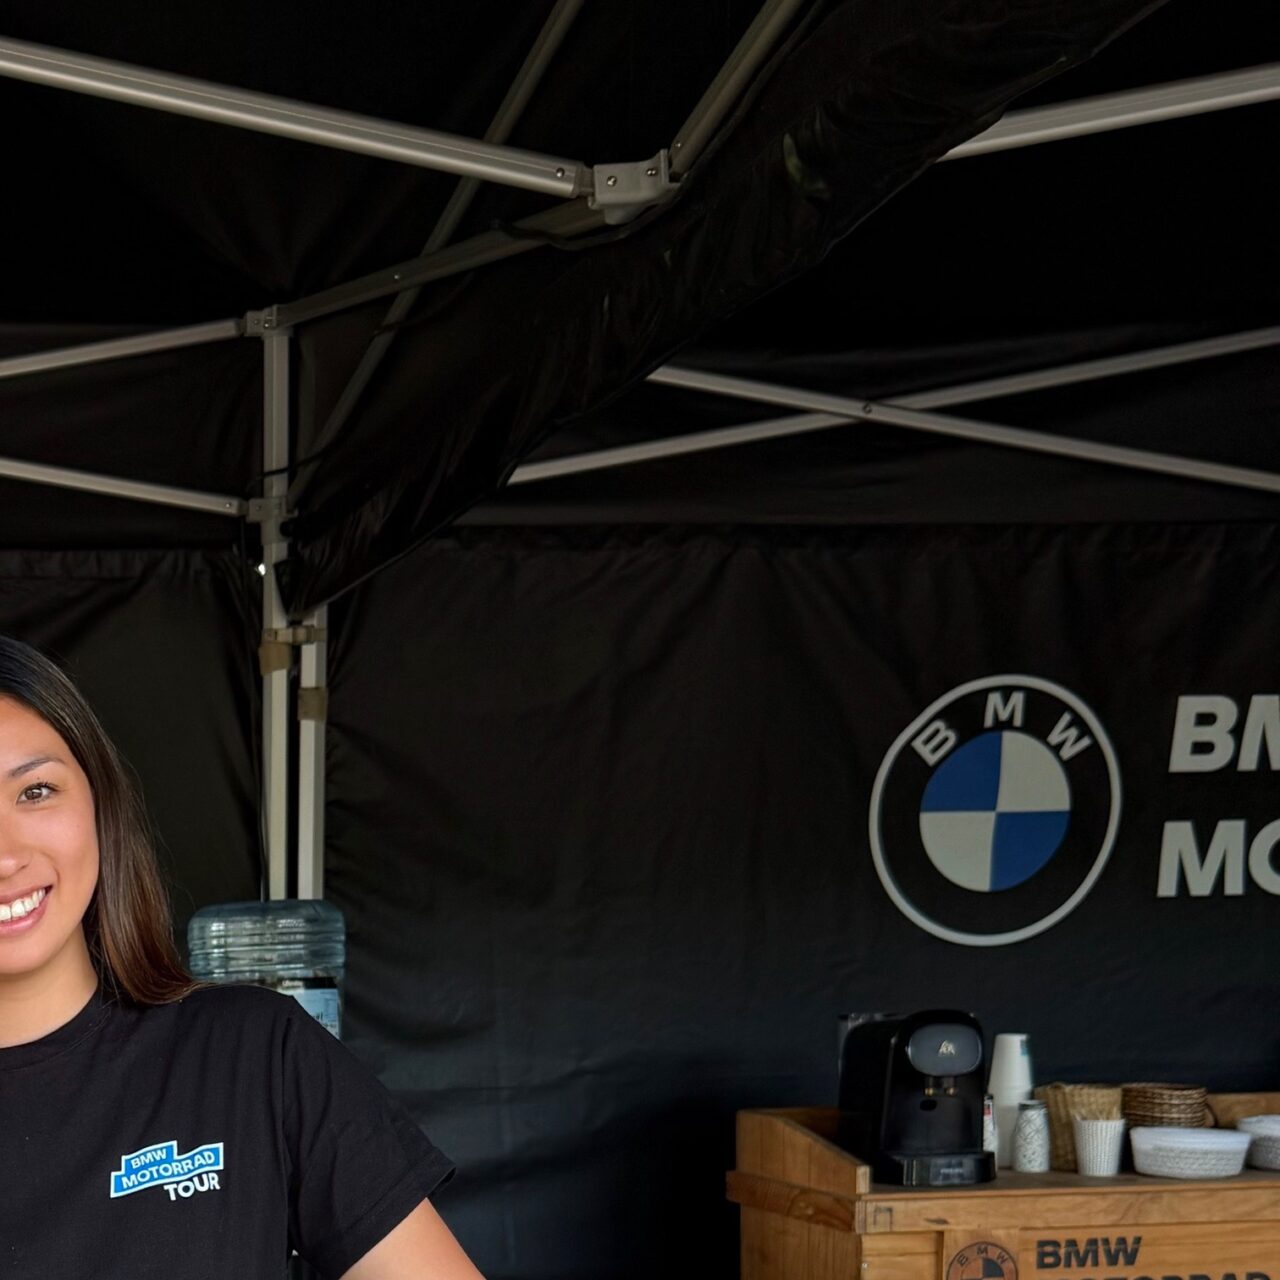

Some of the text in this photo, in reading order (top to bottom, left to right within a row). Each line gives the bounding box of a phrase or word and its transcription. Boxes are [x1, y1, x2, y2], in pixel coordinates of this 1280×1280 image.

[911, 691, 1093, 768] BMW
[121, 1150, 216, 1189] MOTORRAD
[130, 1148, 168, 1169] BMW
[163, 1172, 221, 1201] TOUR
[956, 1245, 1009, 1268] BMW
[1035, 1236, 1143, 1270] BMW
